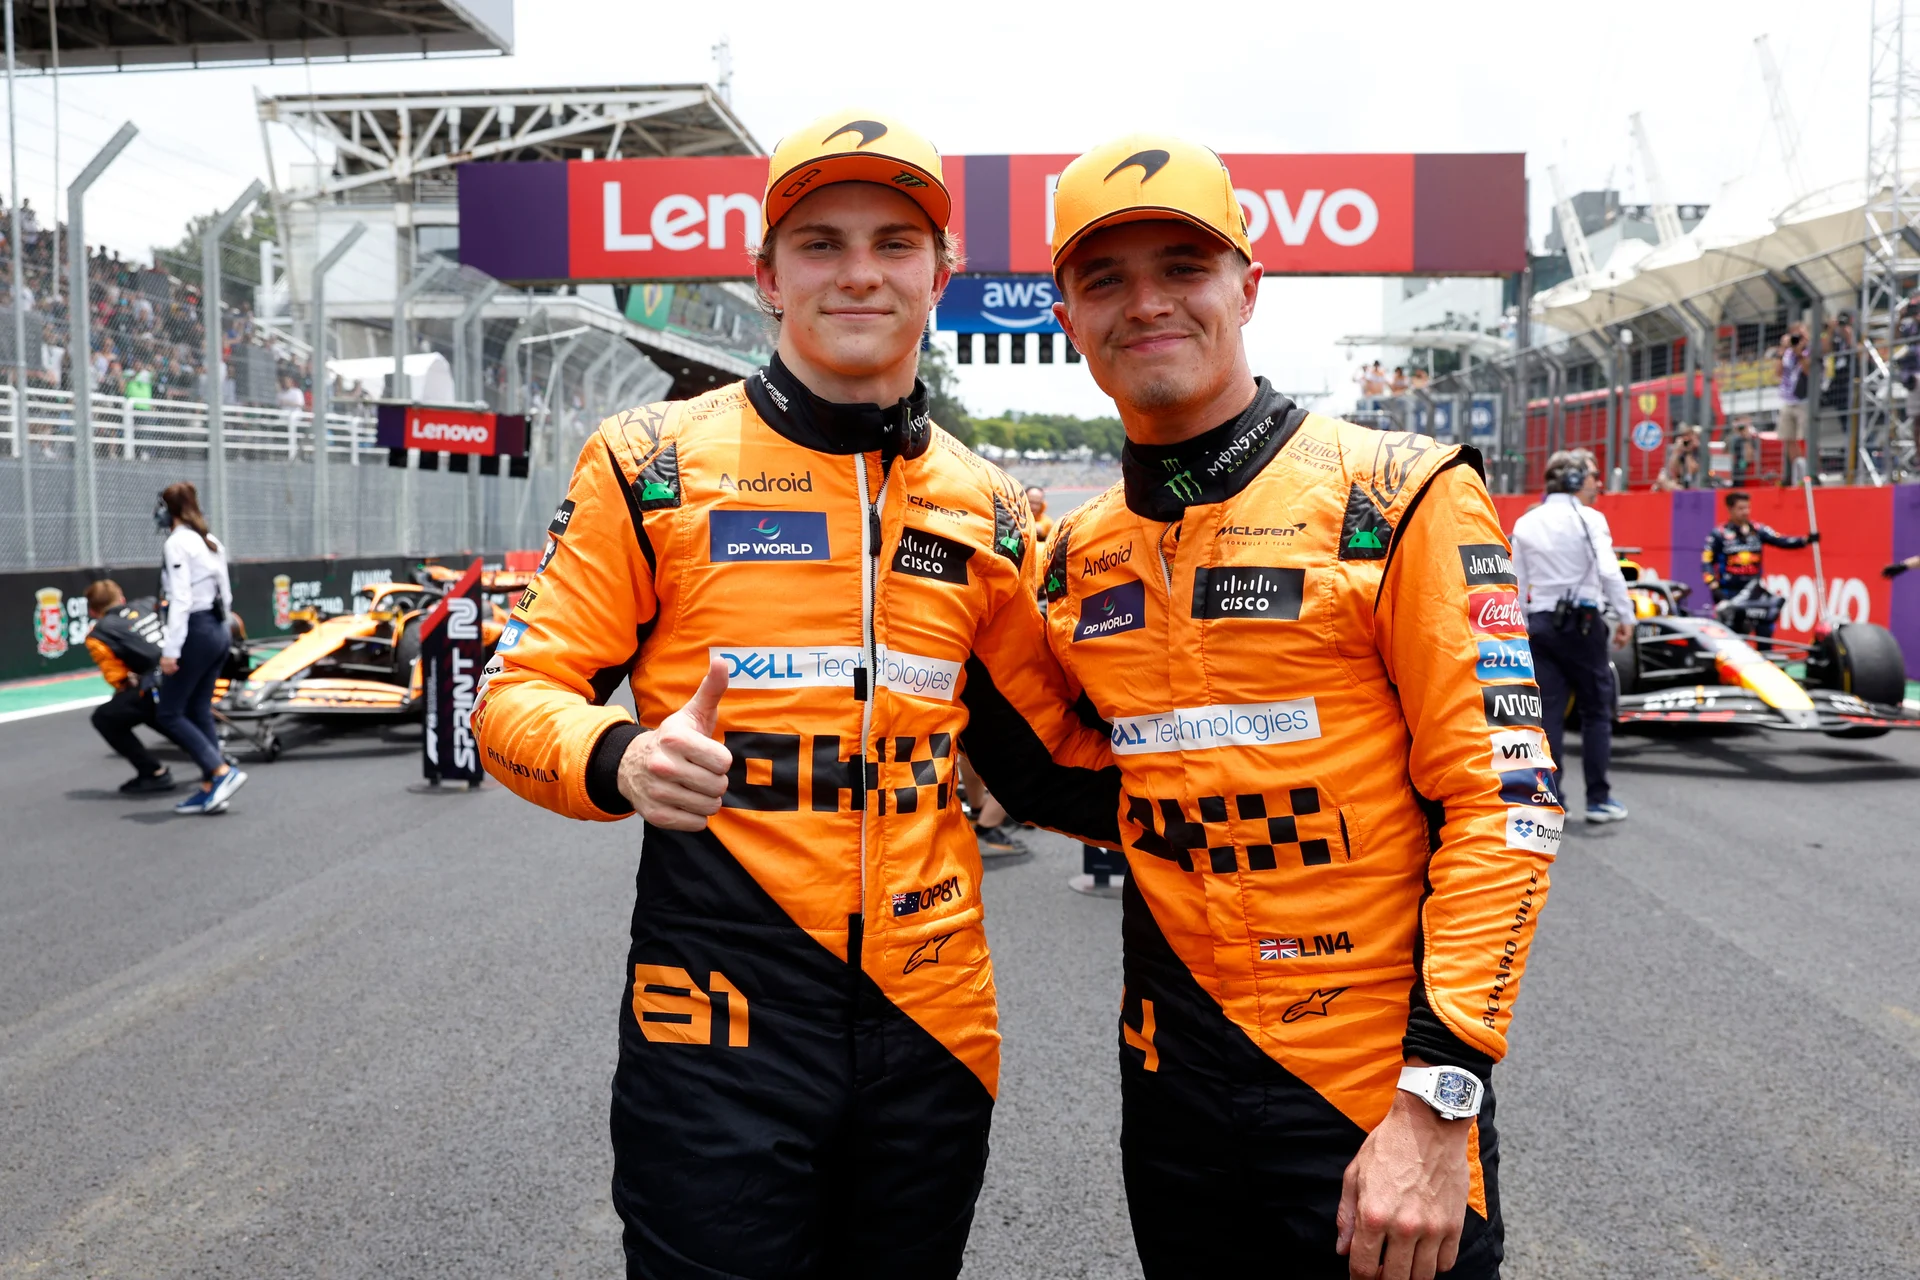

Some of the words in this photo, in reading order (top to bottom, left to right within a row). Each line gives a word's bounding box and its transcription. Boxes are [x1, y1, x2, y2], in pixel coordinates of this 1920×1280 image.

[603, 181, 763, 252] Len
[1234, 187, 1379, 247] ovo
[982, 281, 1053, 308] aws
[765, 382, 789, 404] OPTIMUM
[411, 418, 489, 443] Lenovo
[1207, 416, 1275, 476] MONSTER
[1227, 434, 1271, 474] ENERGY
[1285, 451, 1301, 462] FOR
[1304, 458, 1317, 469] THE
[1319, 464, 1339, 474] STAY
[719, 471, 813, 492] Android
[907, 494, 961, 518] cLaren
[727, 543, 751, 555] DP
[752, 543, 813, 555] WORLD
[1081, 541, 1133, 579] Android
[1469, 554, 1496, 575] JACK
[1477, 598, 1526, 628] Coca-Co
[1764, 574, 1870, 632] novo
[1083, 624, 1099, 635] DP
[1100, 613, 1133, 633] WORLD
[1483, 644, 1533, 668] alter
[720, 652, 803, 681] DELL
[809, 652, 952, 693] Techologies
[452, 647, 476, 774] SPRINT
[1148, 709, 1309, 743] Technologies
[920, 876, 962, 910] OP81
[1298, 931, 1354, 957] LN4
[1482, 940, 1518, 1030] RICHARD
[1510, 870, 1539, 934] MILLE
[632, 963, 749, 1048] 81
